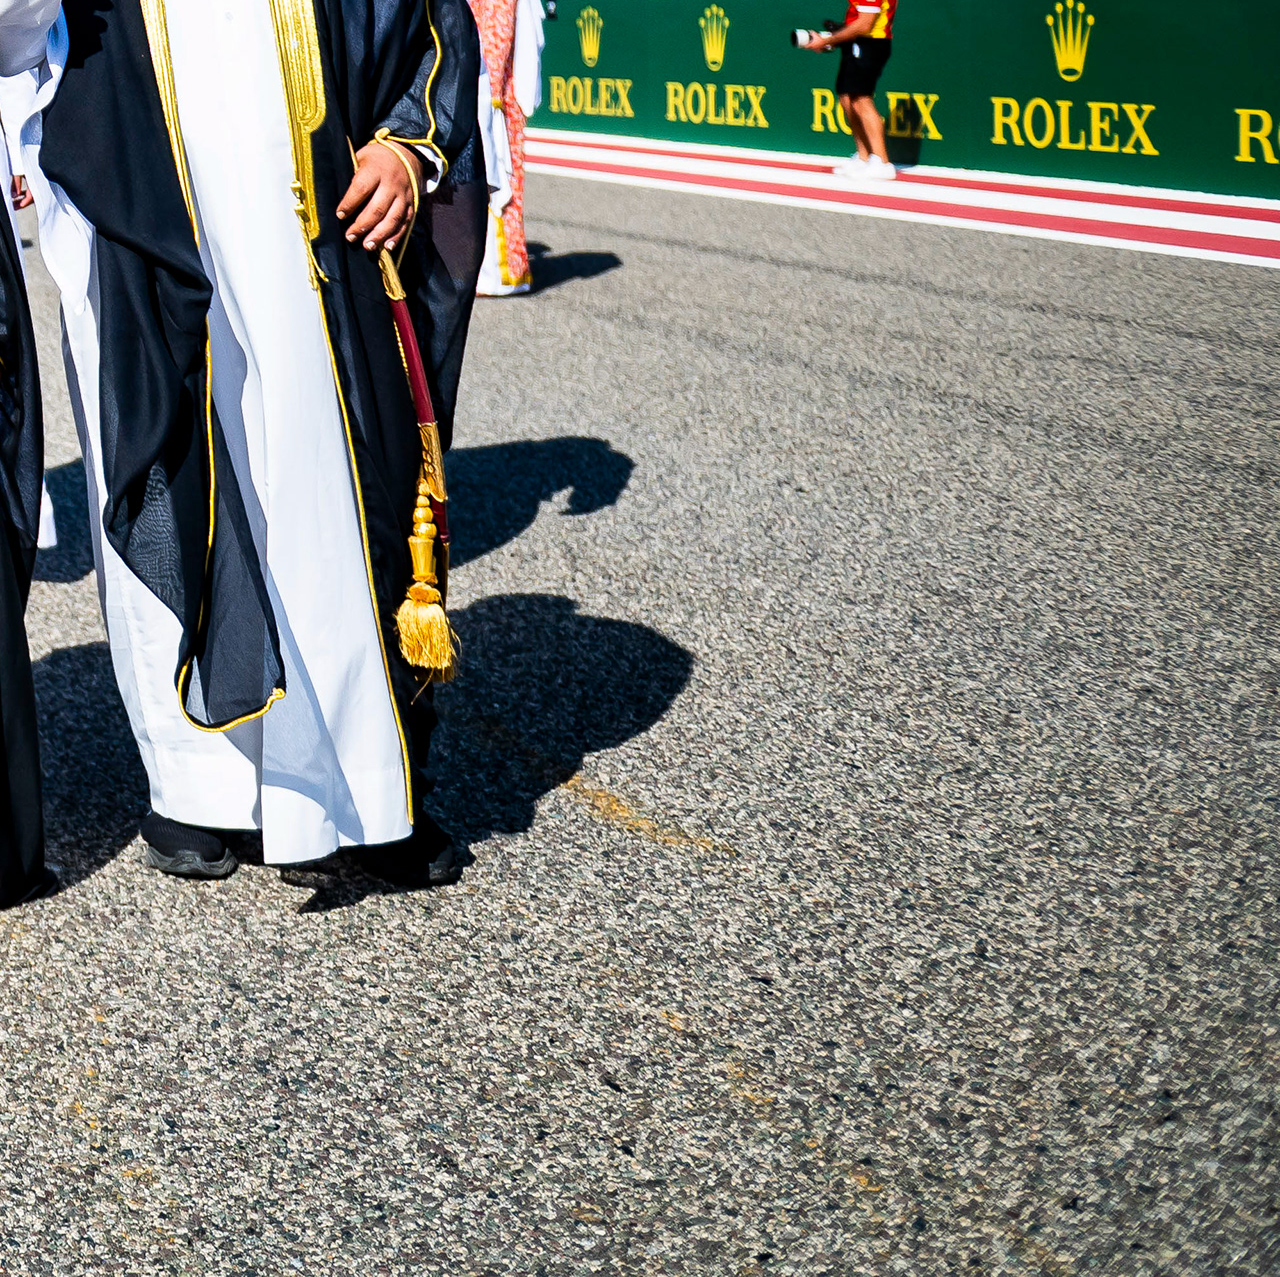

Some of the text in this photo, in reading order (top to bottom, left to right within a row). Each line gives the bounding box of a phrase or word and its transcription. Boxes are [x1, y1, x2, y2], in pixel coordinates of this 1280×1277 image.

[548, 75, 635, 118] ROLEX
[665, 81, 769, 128] ROLEX
[811, 88, 943, 140] REX
[990, 96, 1160, 156] ROLEX
[1234, 108, 1280, 164] R
